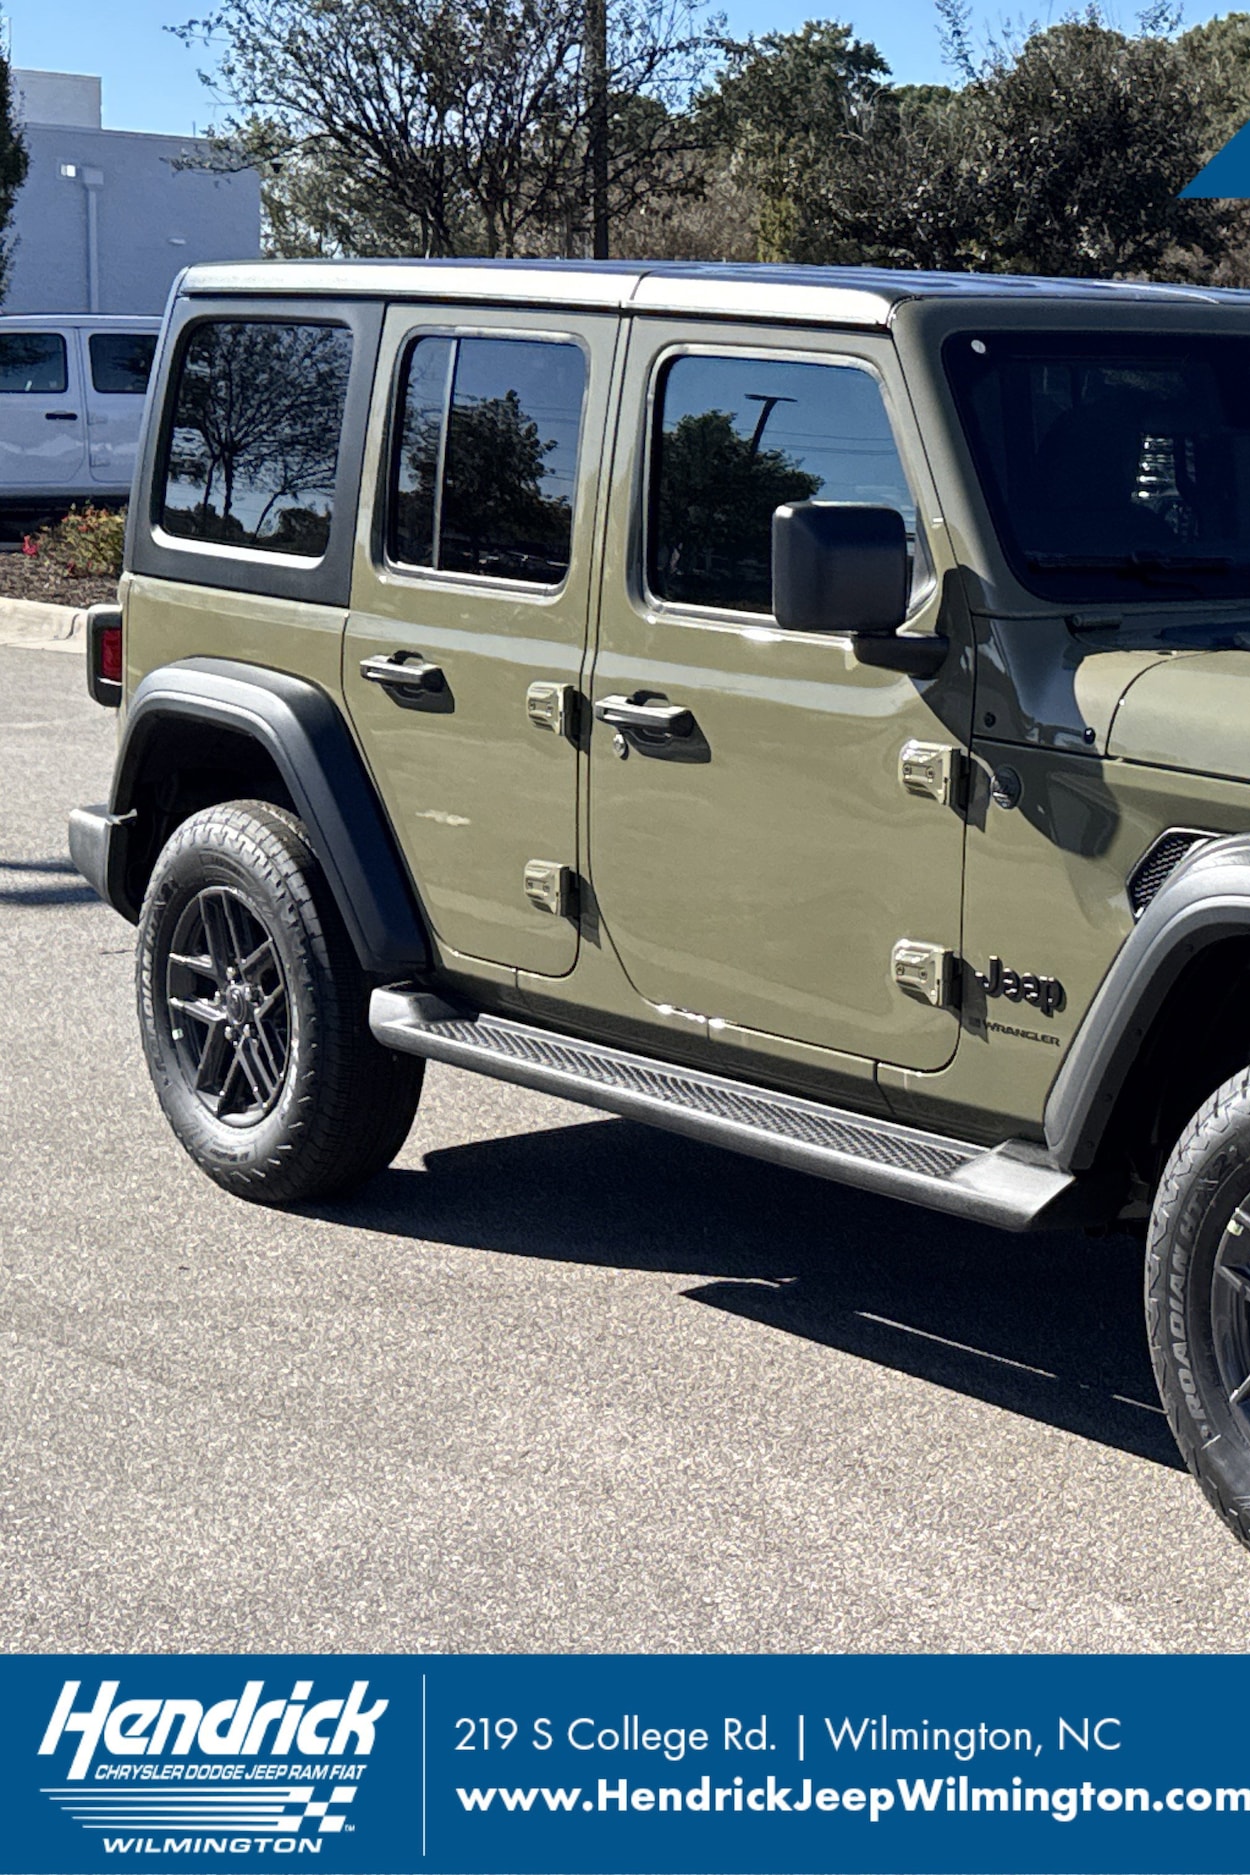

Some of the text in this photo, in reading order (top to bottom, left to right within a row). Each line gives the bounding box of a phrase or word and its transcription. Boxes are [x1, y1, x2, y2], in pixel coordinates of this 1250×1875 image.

[975, 955, 1065, 1018] Jeep
[984, 1020, 1061, 1047] WRANGLER
[1169, 1244, 1207, 1421] ROADIAN
